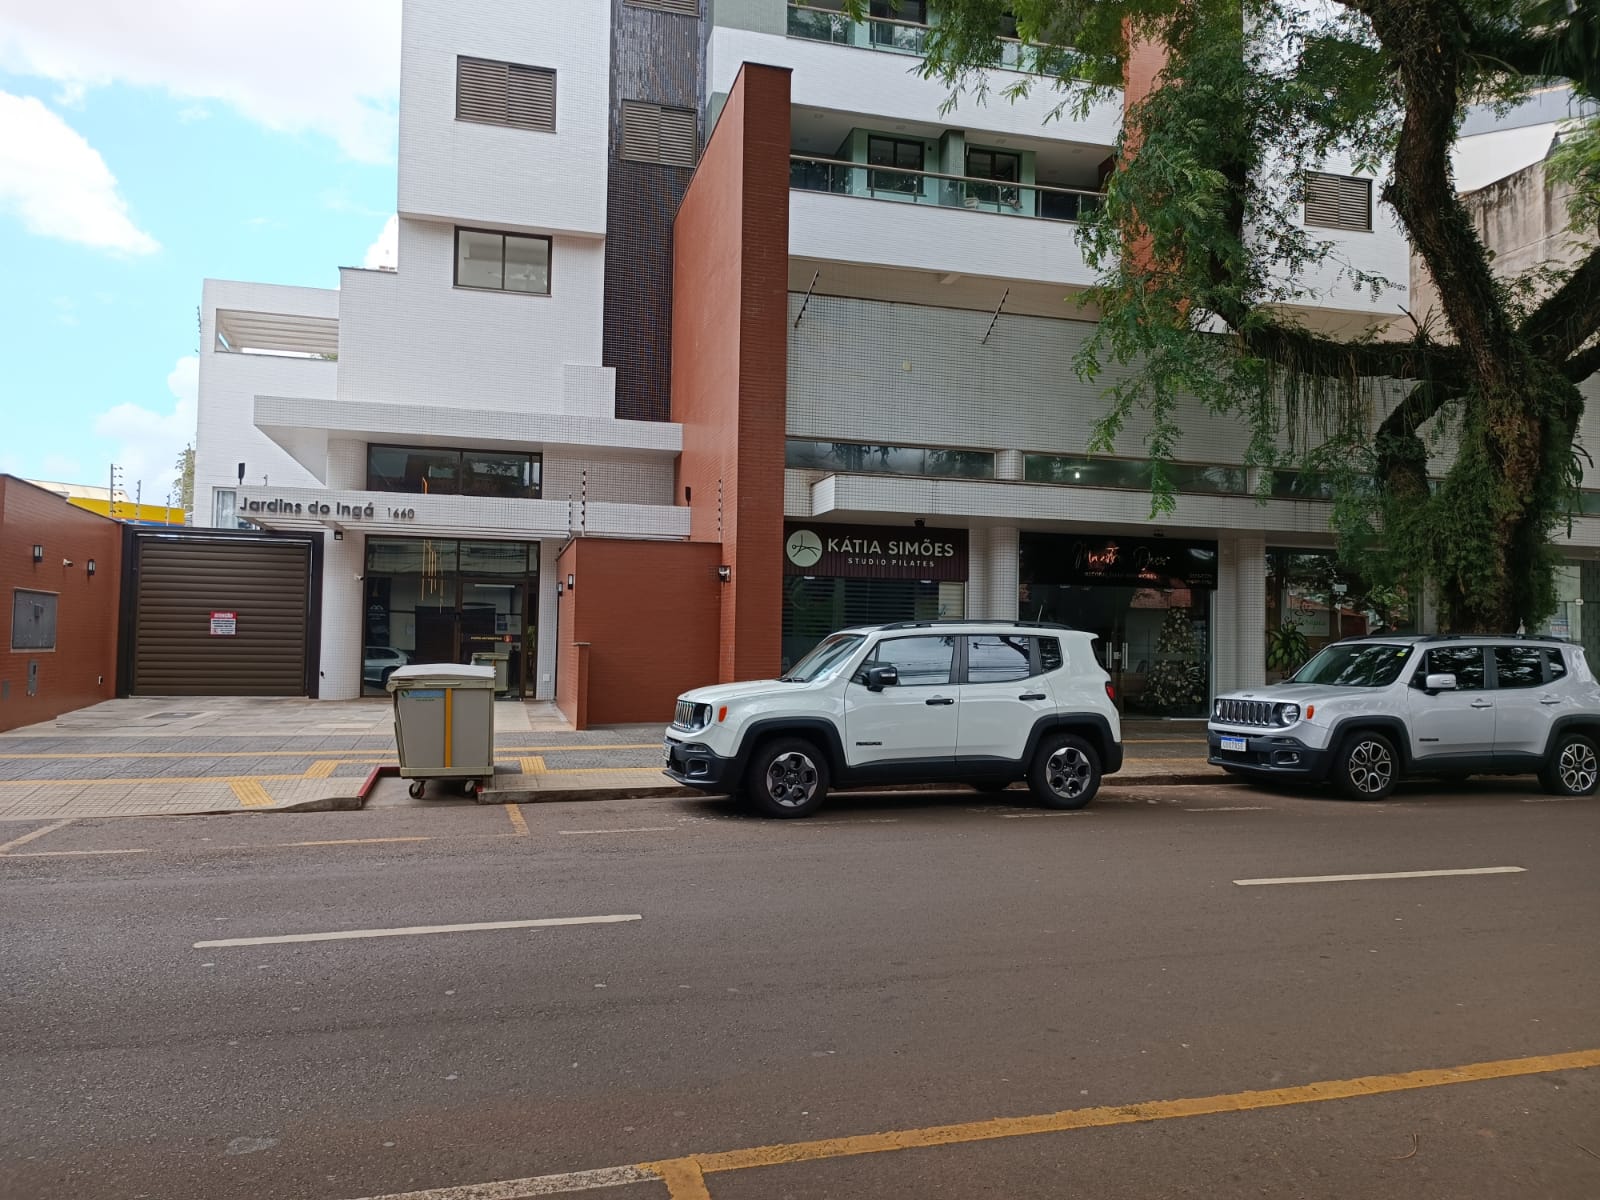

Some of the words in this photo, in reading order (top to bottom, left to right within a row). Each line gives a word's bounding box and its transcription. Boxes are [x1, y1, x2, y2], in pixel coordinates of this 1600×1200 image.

[240, 497, 302, 514] Jardins
[308, 500, 330, 515] do
[336, 502, 375, 520] Ingá
[387, 507, 415, 519] 1660
[828, 535, 882, 554] KÁTIA
[888, 539, 954, 557] SIMÕES
[848, 557, 887, 566] STUDIO
[892, 559, 935, 568] PILATES
